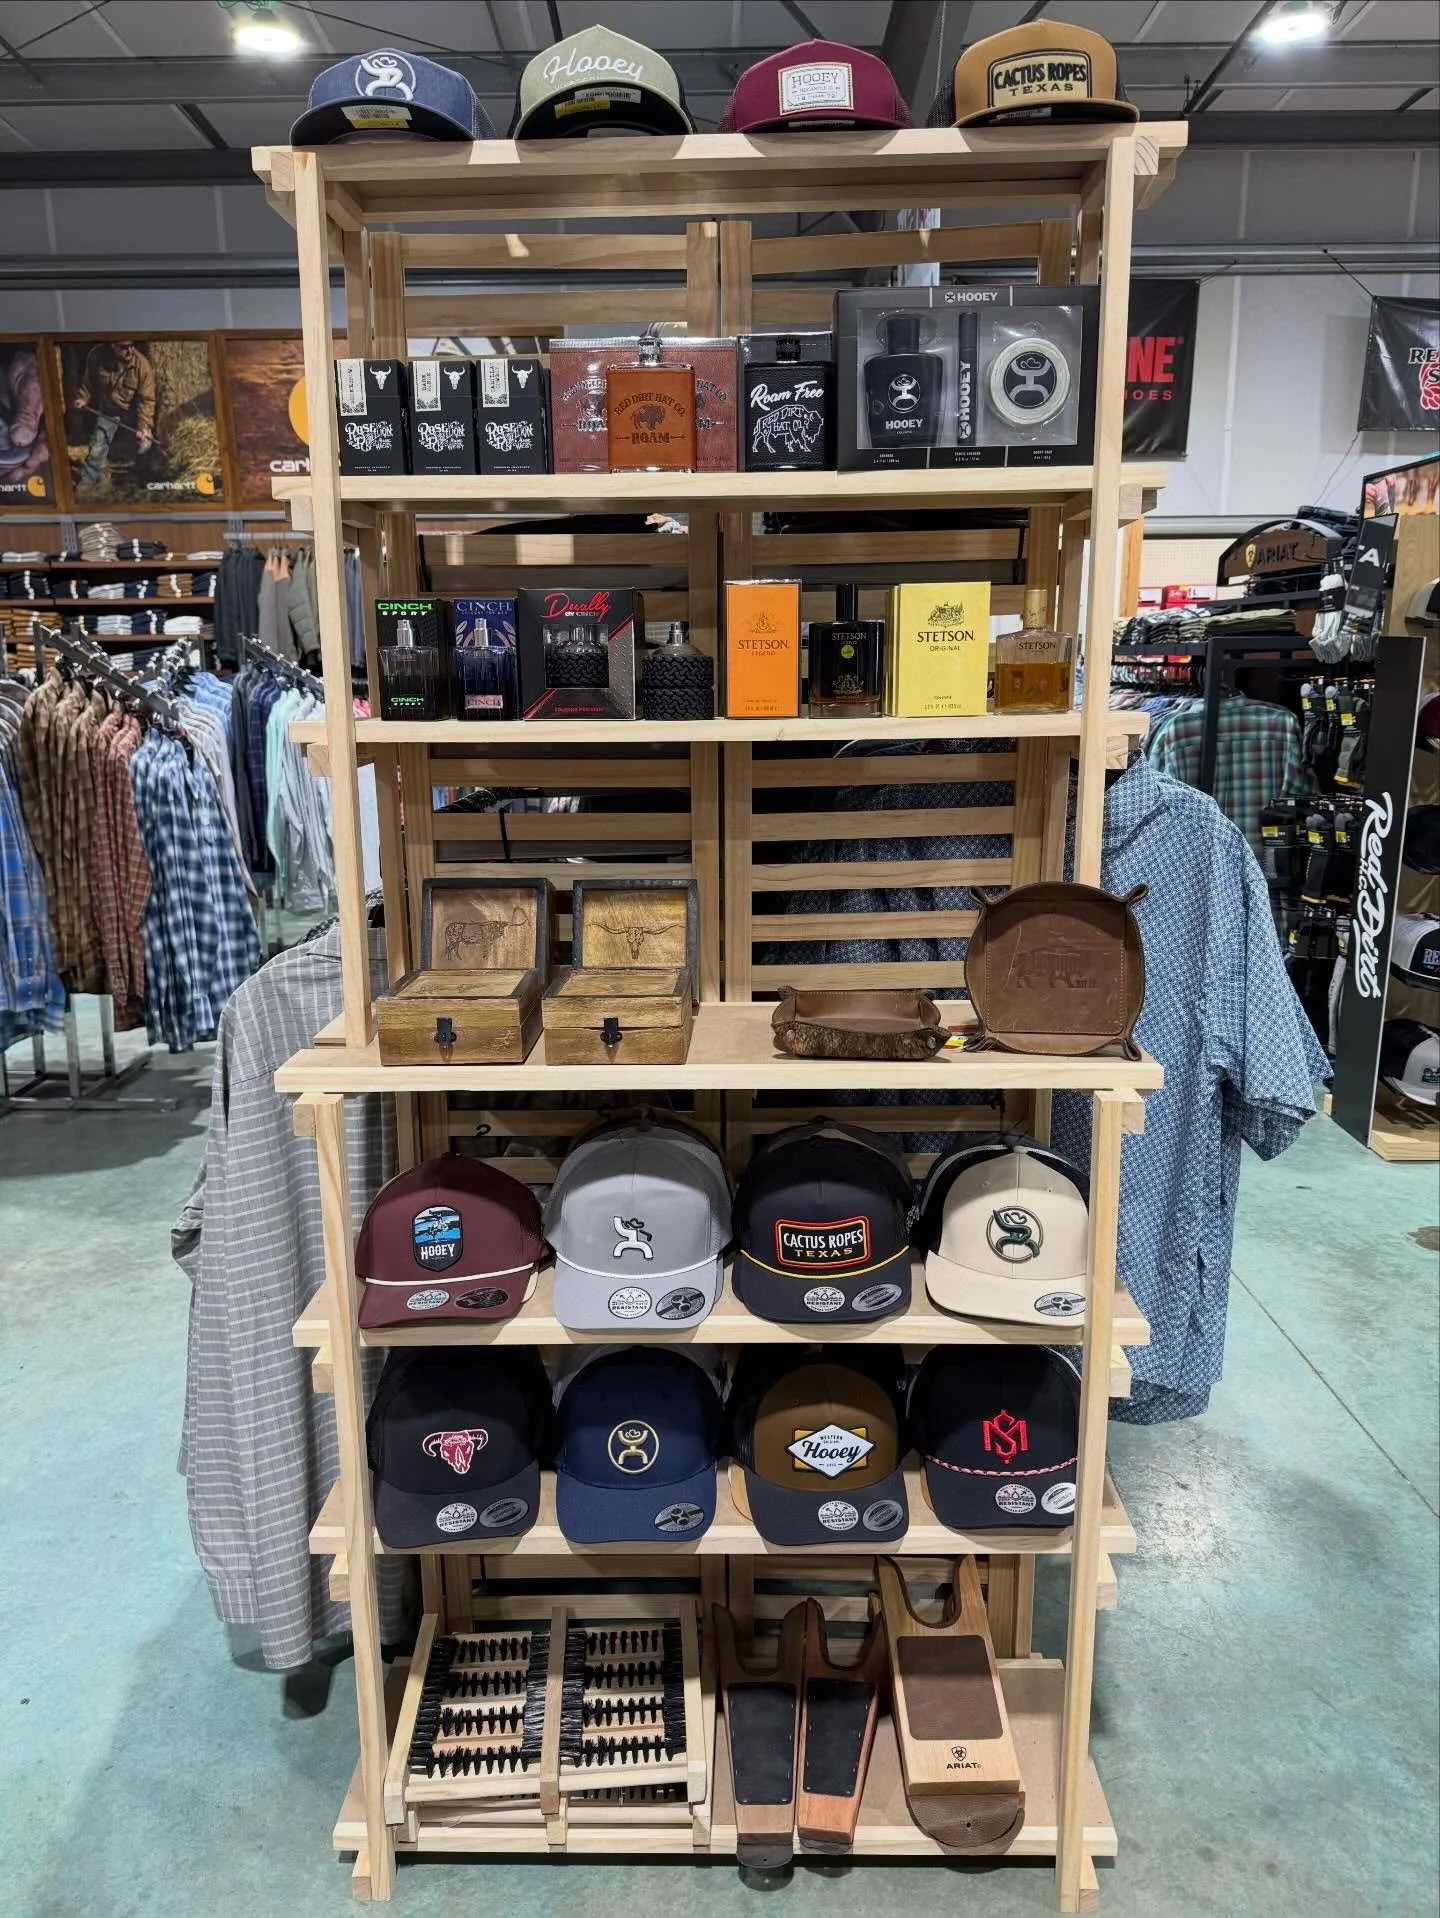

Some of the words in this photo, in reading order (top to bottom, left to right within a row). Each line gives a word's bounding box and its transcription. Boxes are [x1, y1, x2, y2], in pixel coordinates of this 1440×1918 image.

[542, 47, 643, 84] Hooey
[791, 72, 838, 89] HOOEY
[994, 63, 1046, 90] CACTUS
[1047, 62, 1087, 82] ROPES
[1009, 83, 1074, 97] TEXAS
[957, 291, 998, 302] HOOEY
[750, 383, 792, 411] Roam
[794, 380, 825, 402] Free
[959, 360, 971, 421] HOOEY
[1123, 388, 1172, 401] OES
[613, 398, 632, 416] RED
[631, 392, 654, 405] DIRT
[655, 393, 675, 407] HAT
[762, 411, 780, 429] RED
[780, 406, 804, 420] DIRT
[885, 418, 923, 430] HOOEY
[773, 421, 790, 432] HAT
[631, 431, 671, 445] ROAM
[1256, 542, 1299, 565] ARIAT
[377, 602, 432, 611] CINCH
[457, 601, 512, 611] CINCH
[541, 591, 610, 623] Dually
[831, 632, 867, 641] STETSON
[916, 630, 975, 642] STETSON
[738, 639, 789, 650] STETSON
[1019, 641, 1056, 650] STETSON
[1360, 791, 1393, 894] Red
[1353, 887, 1386, 999] Dirt
[783, 1231, 826, 1249] CACTUS
[828, 1228, 864, 1249] ROPES
[420, 1243, 456, 1260] HOOEY
[794, 1247, 853, 1258] TEXAS
[802, 1440, 861, 1463] Hooey
[439, 1517, 475, 1528] RESISTANT
[822, 1516, 857, 1524] RESISTANT
